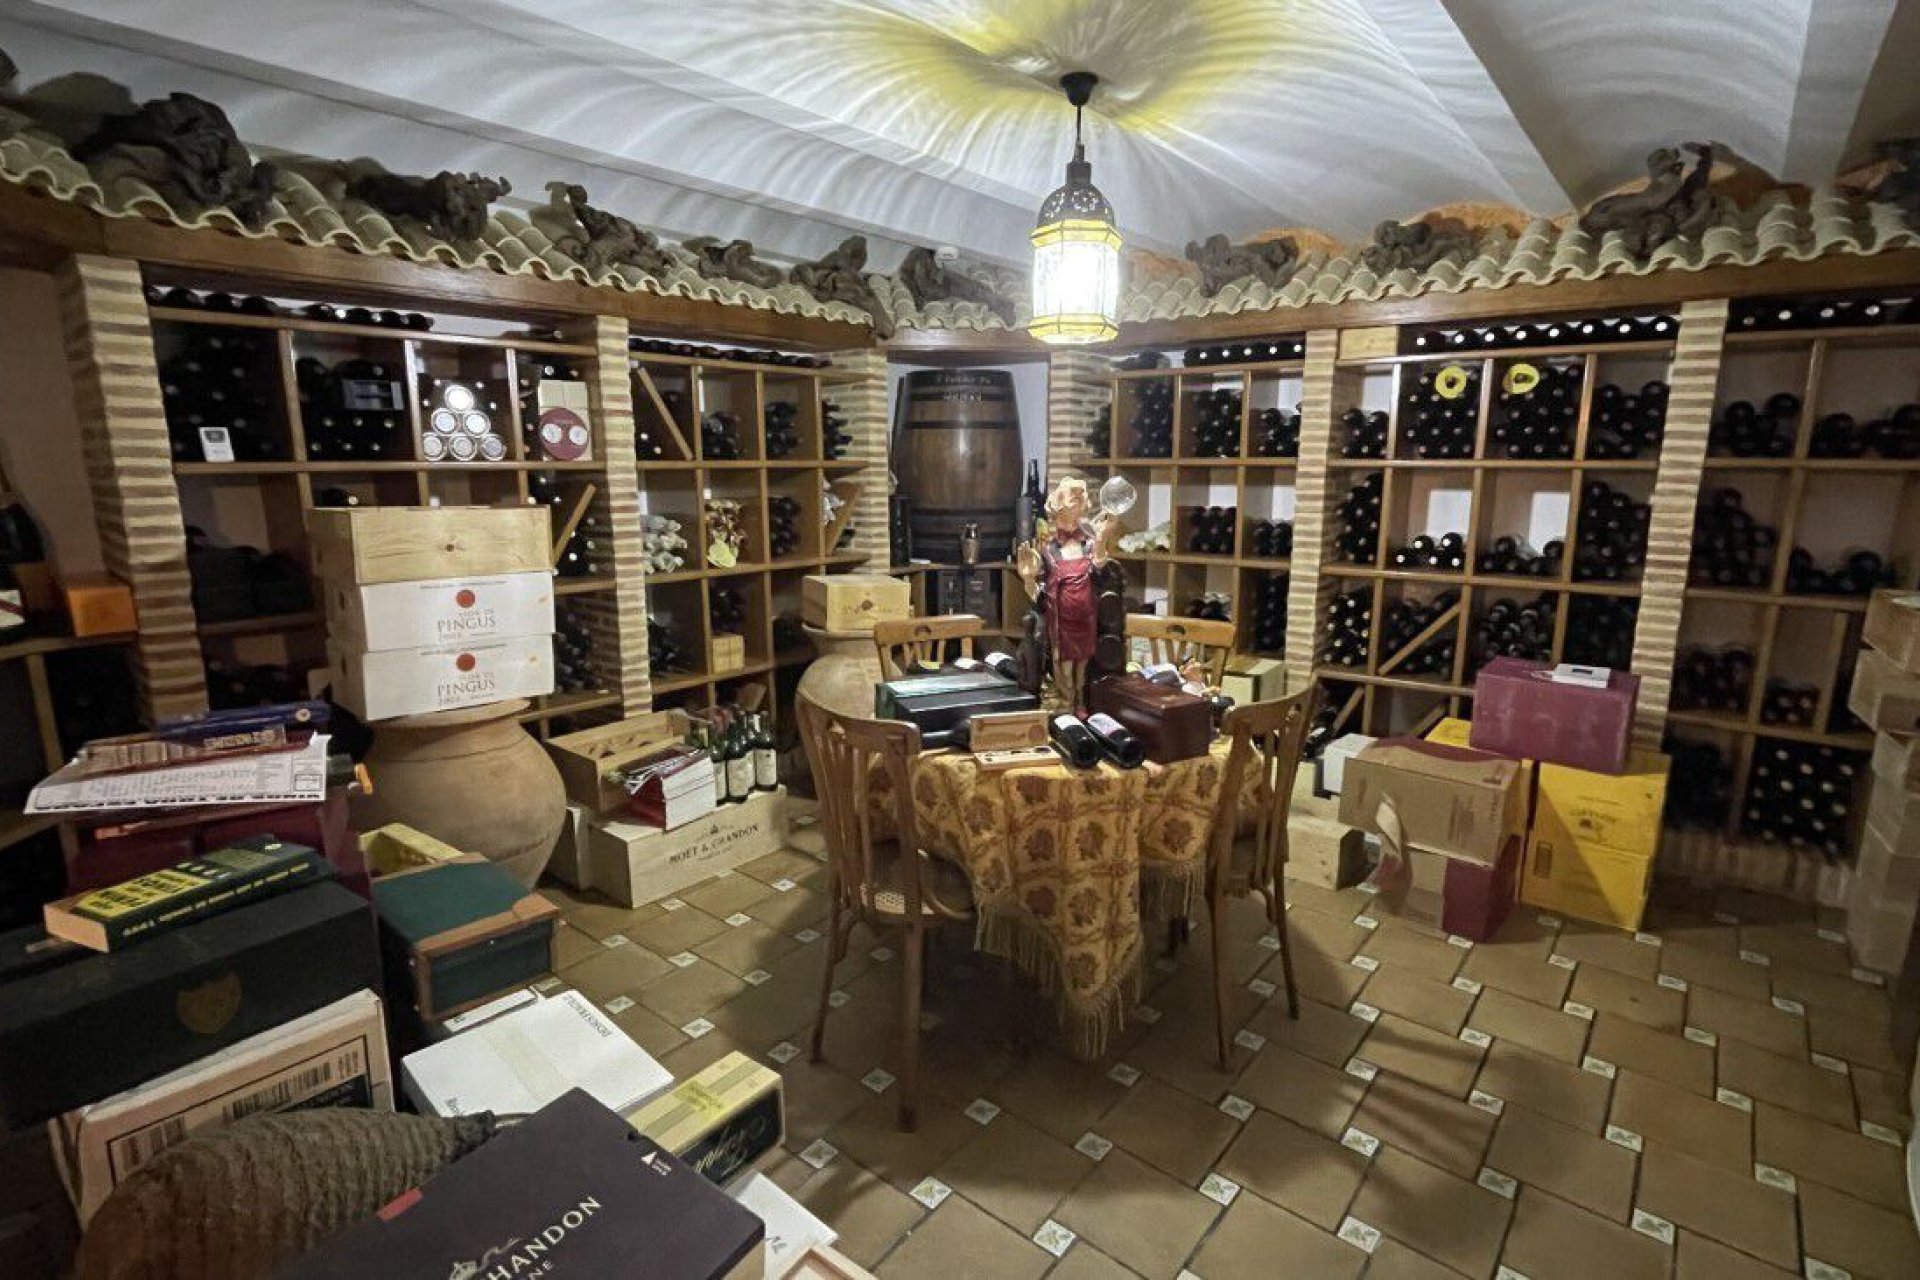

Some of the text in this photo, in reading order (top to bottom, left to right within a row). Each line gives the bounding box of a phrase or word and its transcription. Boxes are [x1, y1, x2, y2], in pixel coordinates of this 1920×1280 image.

[438, 617, 496, 632] PINGUS
[438, 679, 495, 696] PINGUS
[487, 1196, 602, 1280] HANDON
